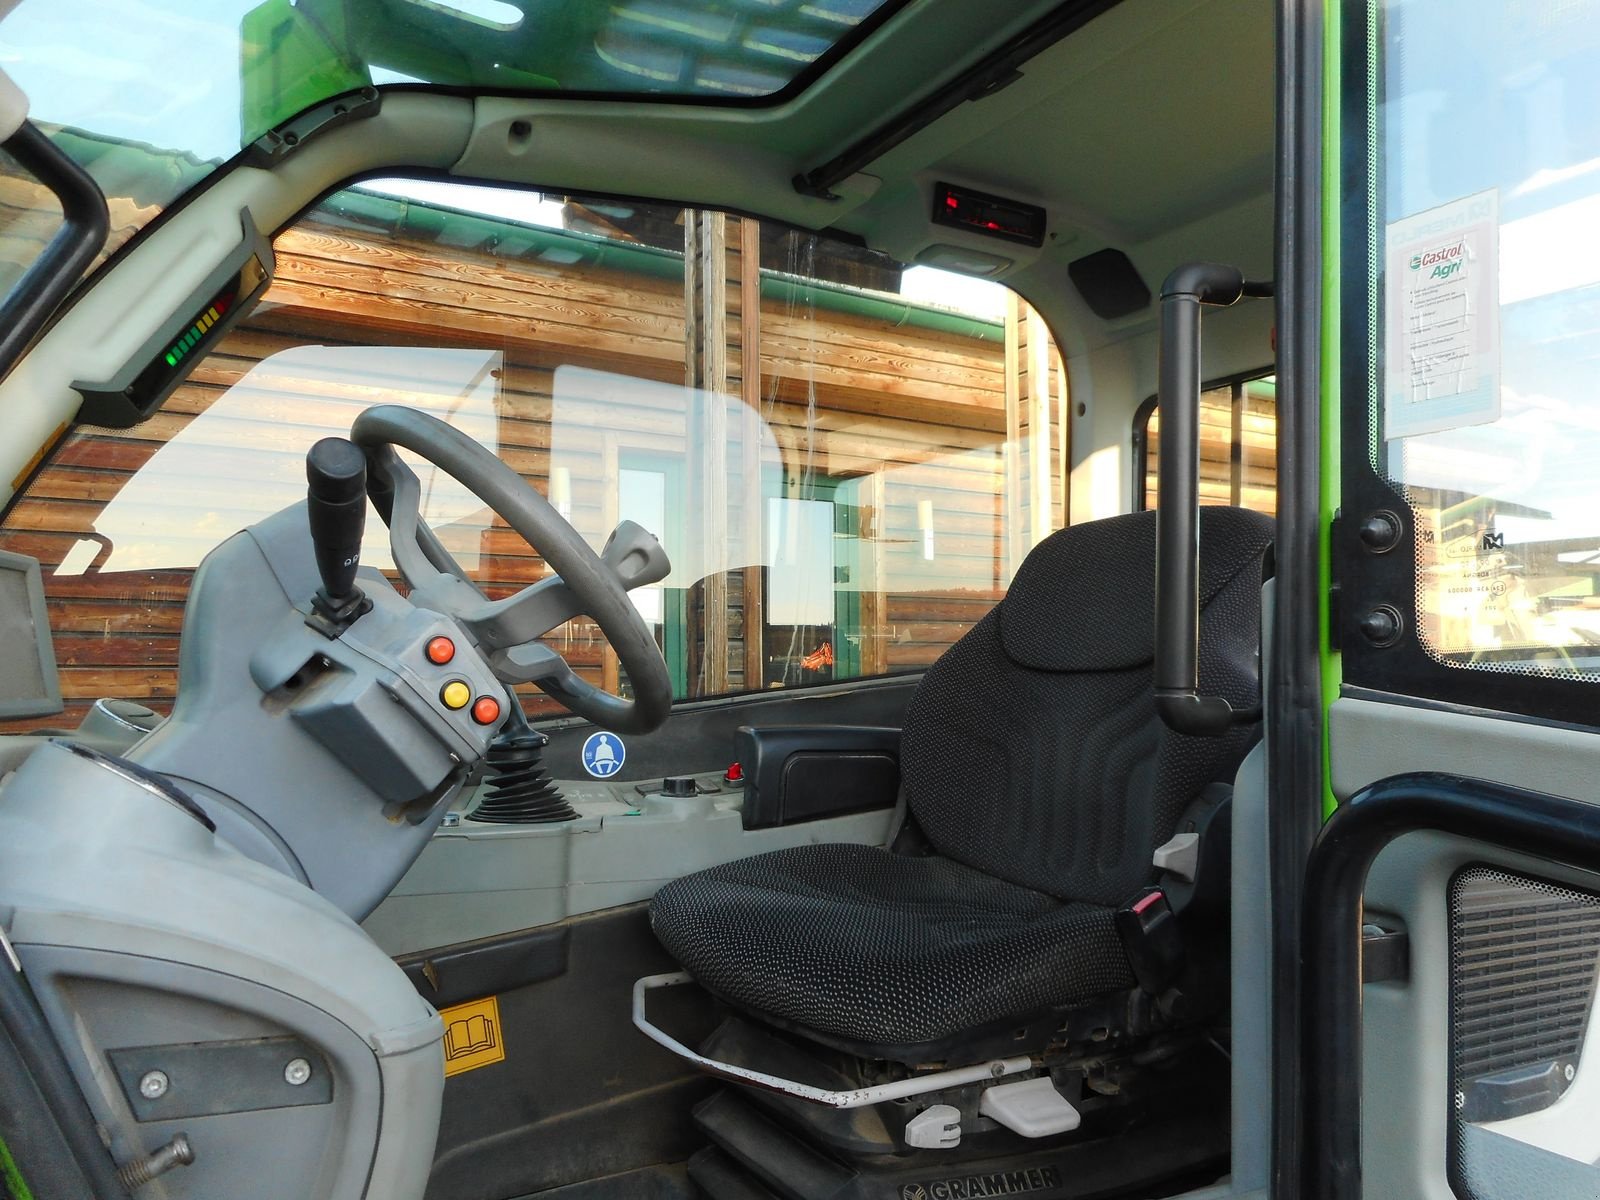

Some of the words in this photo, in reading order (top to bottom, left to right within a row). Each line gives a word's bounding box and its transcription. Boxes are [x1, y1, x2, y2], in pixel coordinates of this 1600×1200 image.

[1422, 243, 1462, 266] Castrol
[1430, 258, 1463, 279] Agri
[931, 1168, 1055, 1200] GRAMMER
